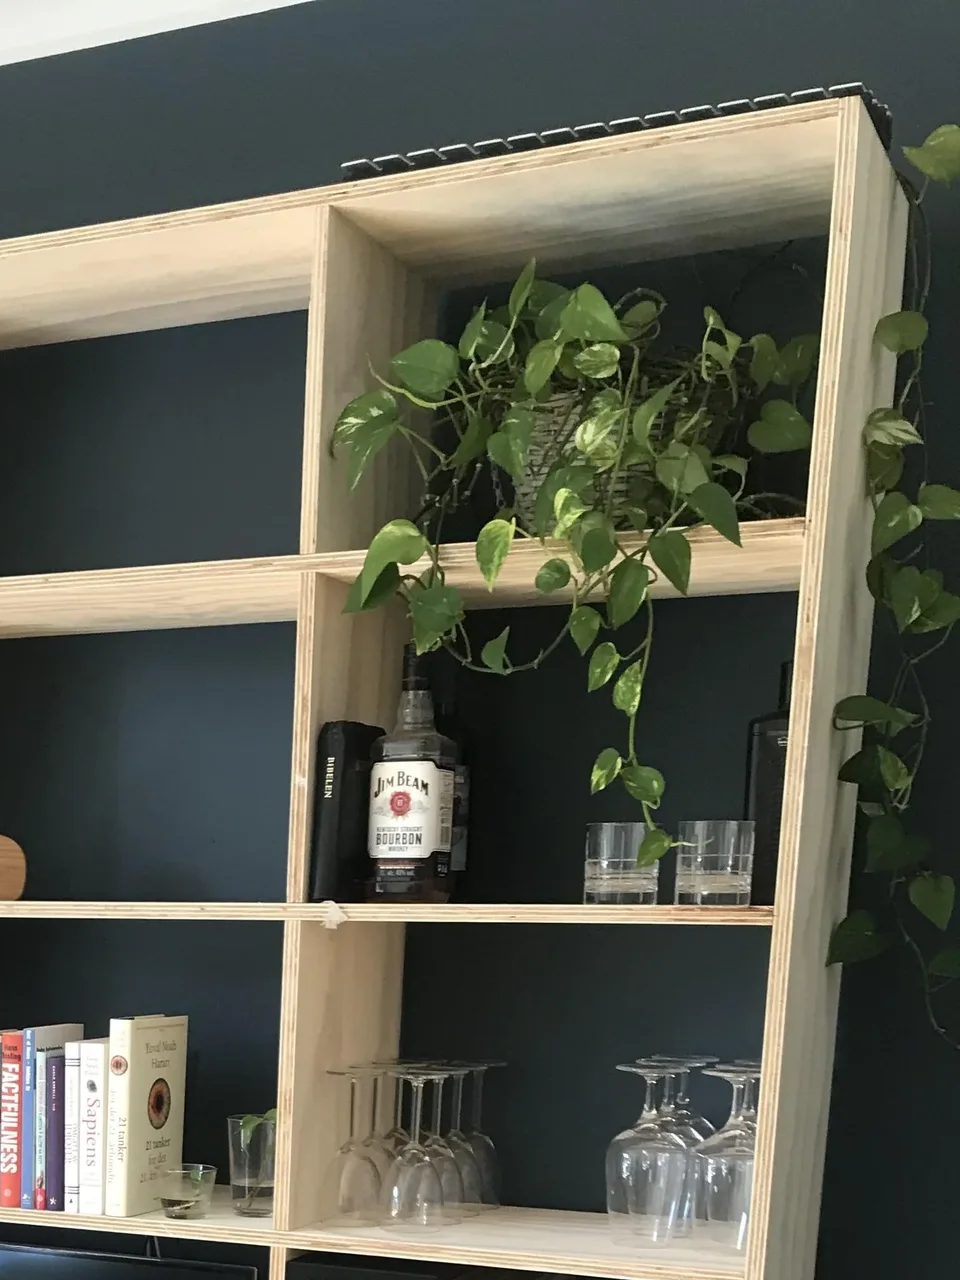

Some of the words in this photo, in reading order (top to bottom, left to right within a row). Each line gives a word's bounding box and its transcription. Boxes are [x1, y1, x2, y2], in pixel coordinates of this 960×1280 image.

[374, 776, 394, 798] JIM
[397, 771, 429, 796] BEAM
[376, 833, 422, 845] BOURBON
[0, 1063, 20, 1174] FACTFULNESS
[82, 1097, 101, 1167] Sapiens
[118, 1117, 127, 1126] 21
[117, 1131, 127, 1163] tanker
